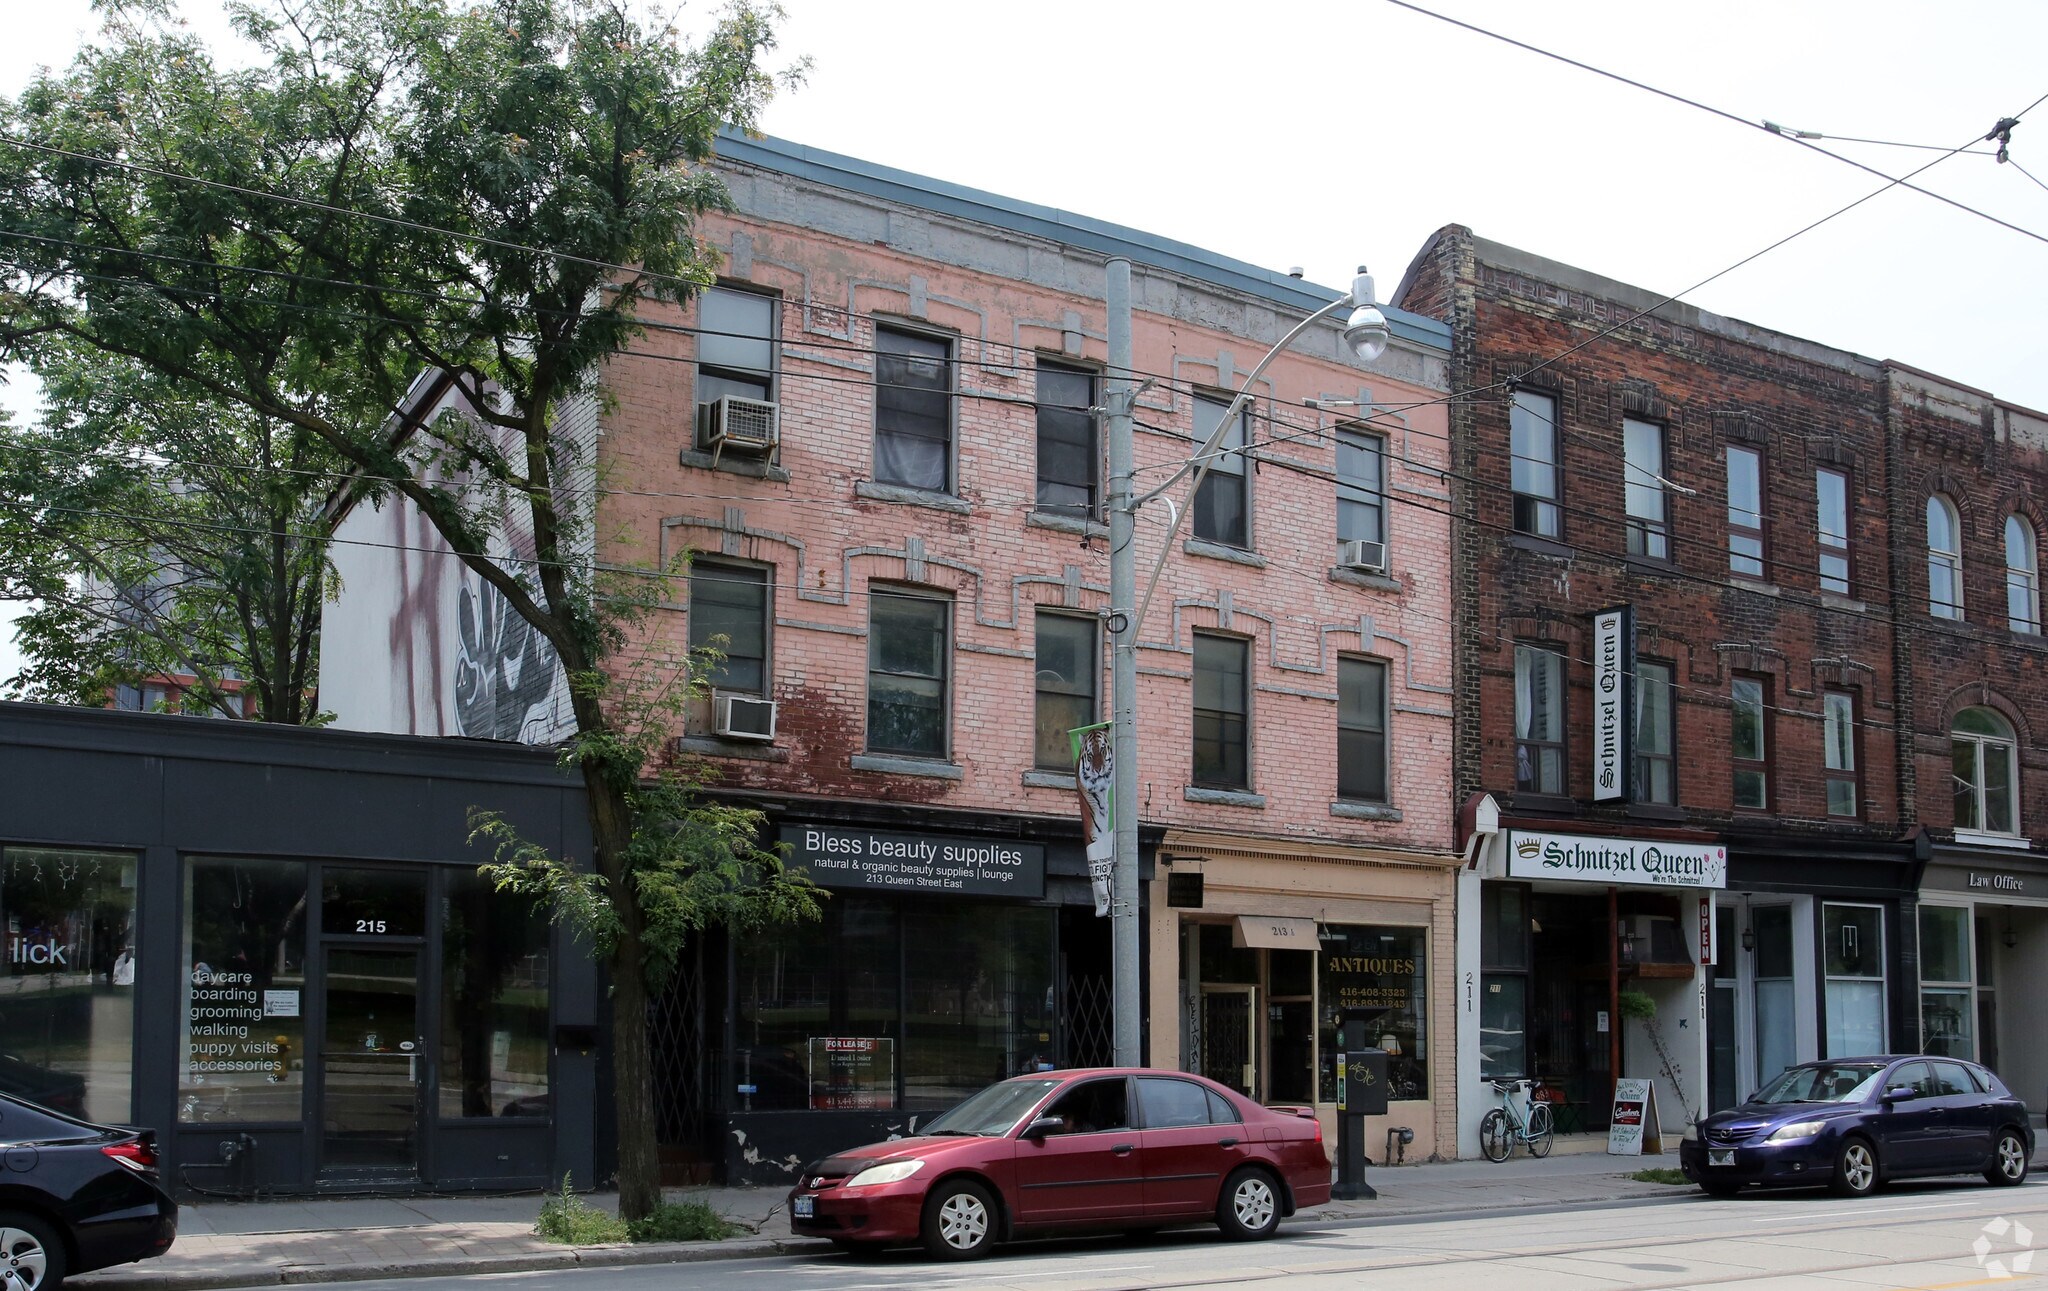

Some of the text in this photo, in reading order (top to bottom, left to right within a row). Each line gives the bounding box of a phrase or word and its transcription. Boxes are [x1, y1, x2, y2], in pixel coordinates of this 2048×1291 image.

[1599, 634, 1617, 789] Schnitzel Queen
[805, 831, 1022, 868] Bless beauty supplies
[1542, 841, 1704, 876] Schnitzel Queen
[814, 858, 849, 869] natural
[852, 860, 860, 870] &
[862, 861, 899, 874] organic
[900, 862, 933, 876] beauty
[936, 864, 974, 878] supplies
[982, 868, 1014, 881] lounge
[866, 873, 963, 889] 213 Queen Street East
[1652, 874, 1667, 883] We're
[1668, 875, 1677, 884] The
[1969, 872, 2023, 890] Law Office
[356, 919, 386, 933] 215
[1272, 926, 1288, 936] 213
[1701, 904, 1709, 959] OPEN
[13, 937, 67, 965] lick
[1329, 957, 1415, 976] ANTIQUES
[191, 970, 252, 985] daycare
[190, 987, 257, 1003] boarding
[190, 1005, 262, 1021] grooming
[190, 1023, 248, 1039] walking
[189, 1040, 279, 1056] puppy visits
[827, 1040, 842, 1048] FOR
[843, 1040, 866, 1048] LEASE
[189, 1058, 282, 1071] accessories
